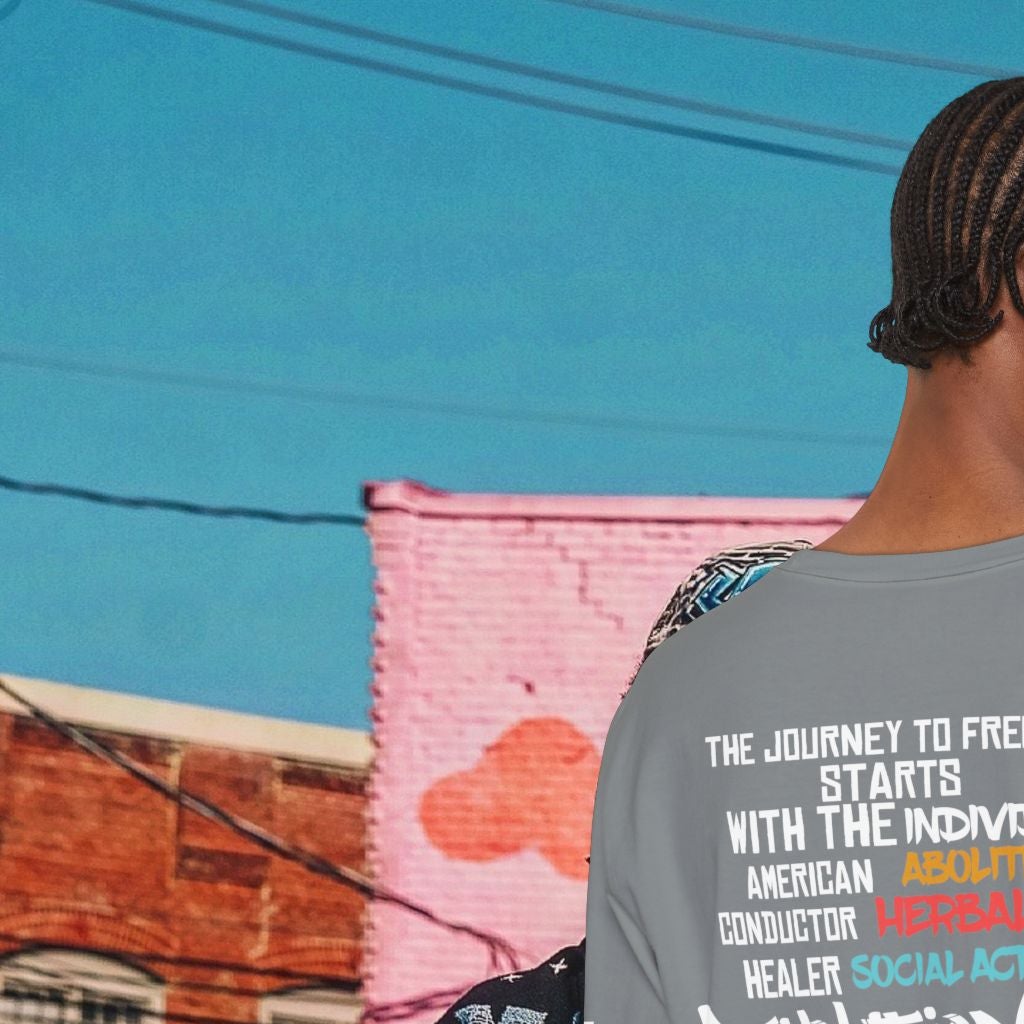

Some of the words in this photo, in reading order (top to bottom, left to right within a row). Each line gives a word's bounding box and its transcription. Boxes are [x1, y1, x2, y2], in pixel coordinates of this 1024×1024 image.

[704, 732, 755, 768] THE
[763, 719, 903, 763] JOURNEY
[913, 717, 951, 753] TO
[819, 758, 962, 803] STARTS
[726, 806, 806, 855] WITH
[816, 801, 898, 850] THE
[746, 858, 874, 900] AMERICAN
[717, 906, 859, 946] CONDUCTOR
[742, 955, 843, 1000] HEALER
[850, 951, 964, 989] SOCIAL
